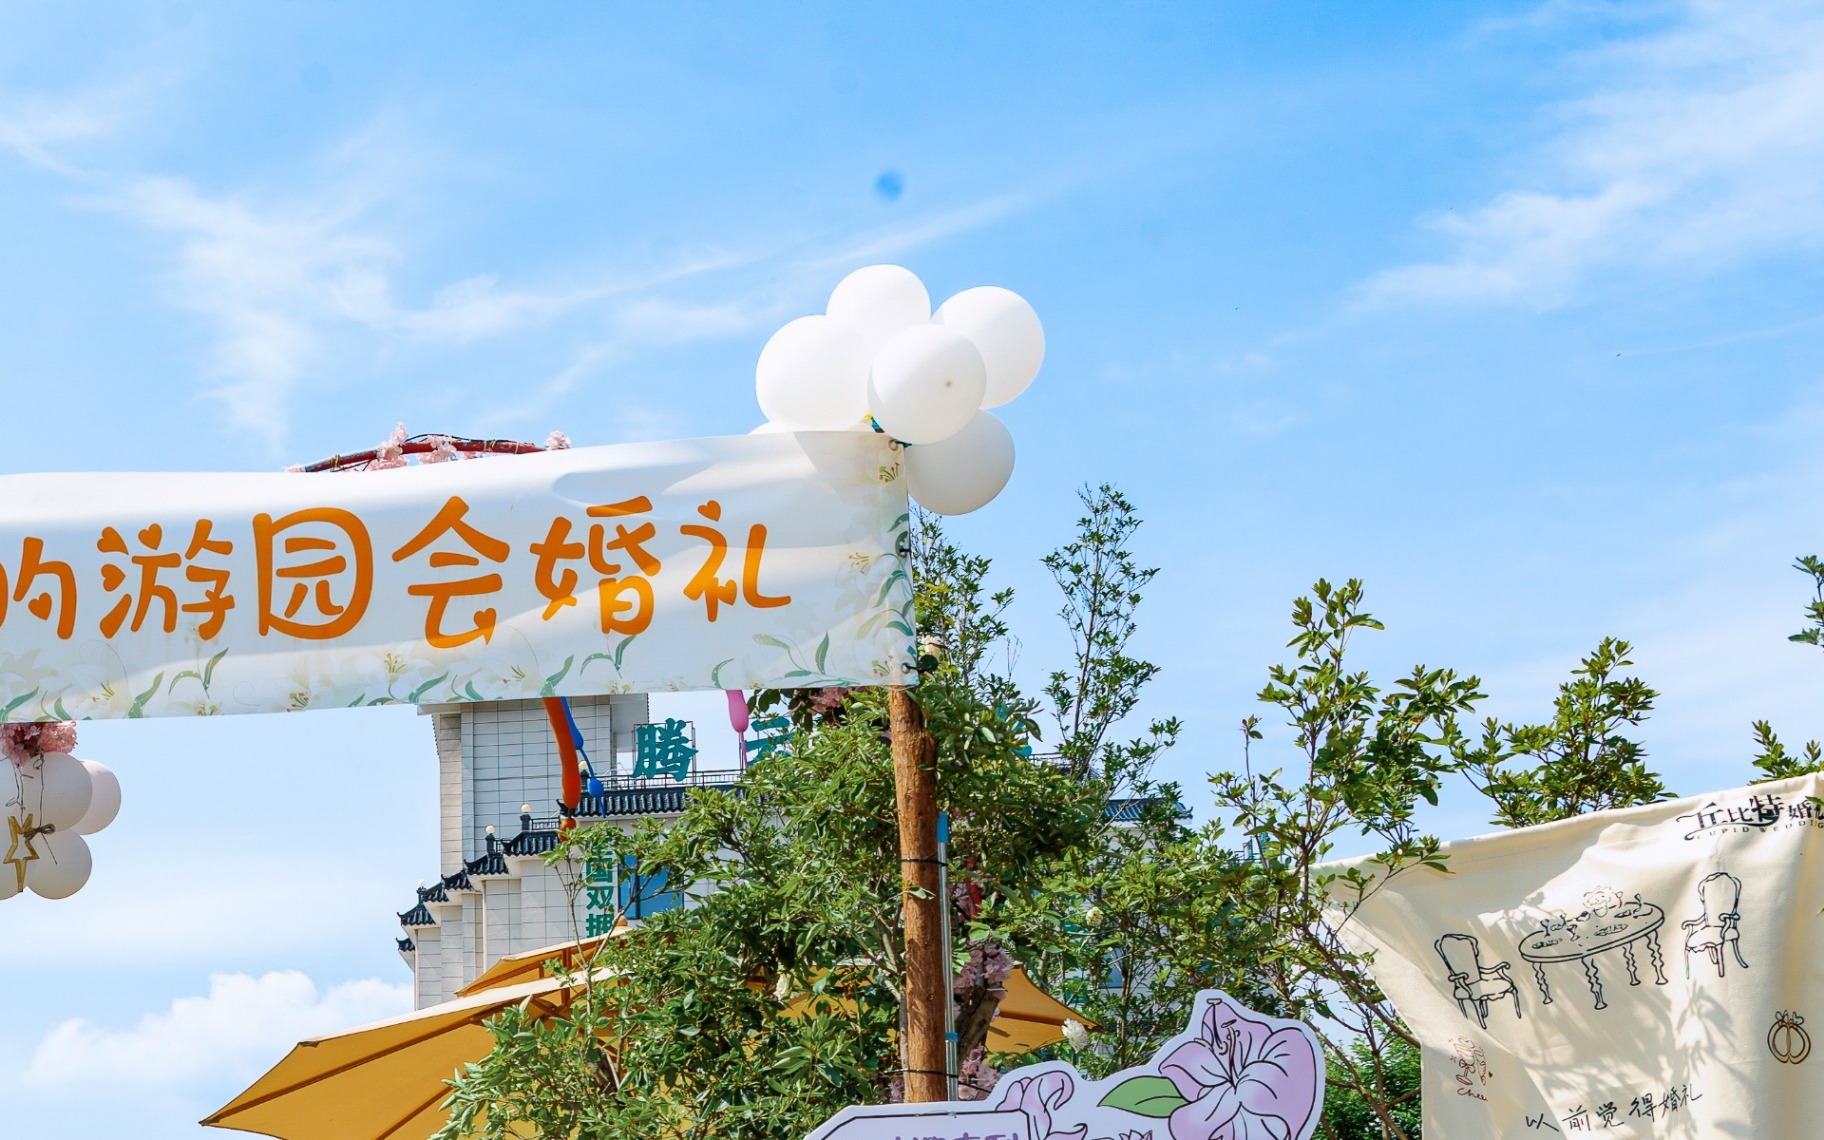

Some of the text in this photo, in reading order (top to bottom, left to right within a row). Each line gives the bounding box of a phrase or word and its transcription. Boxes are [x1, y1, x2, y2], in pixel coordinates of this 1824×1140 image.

[1525, 1083, 1703, 1132] 以前觉得婚礼
